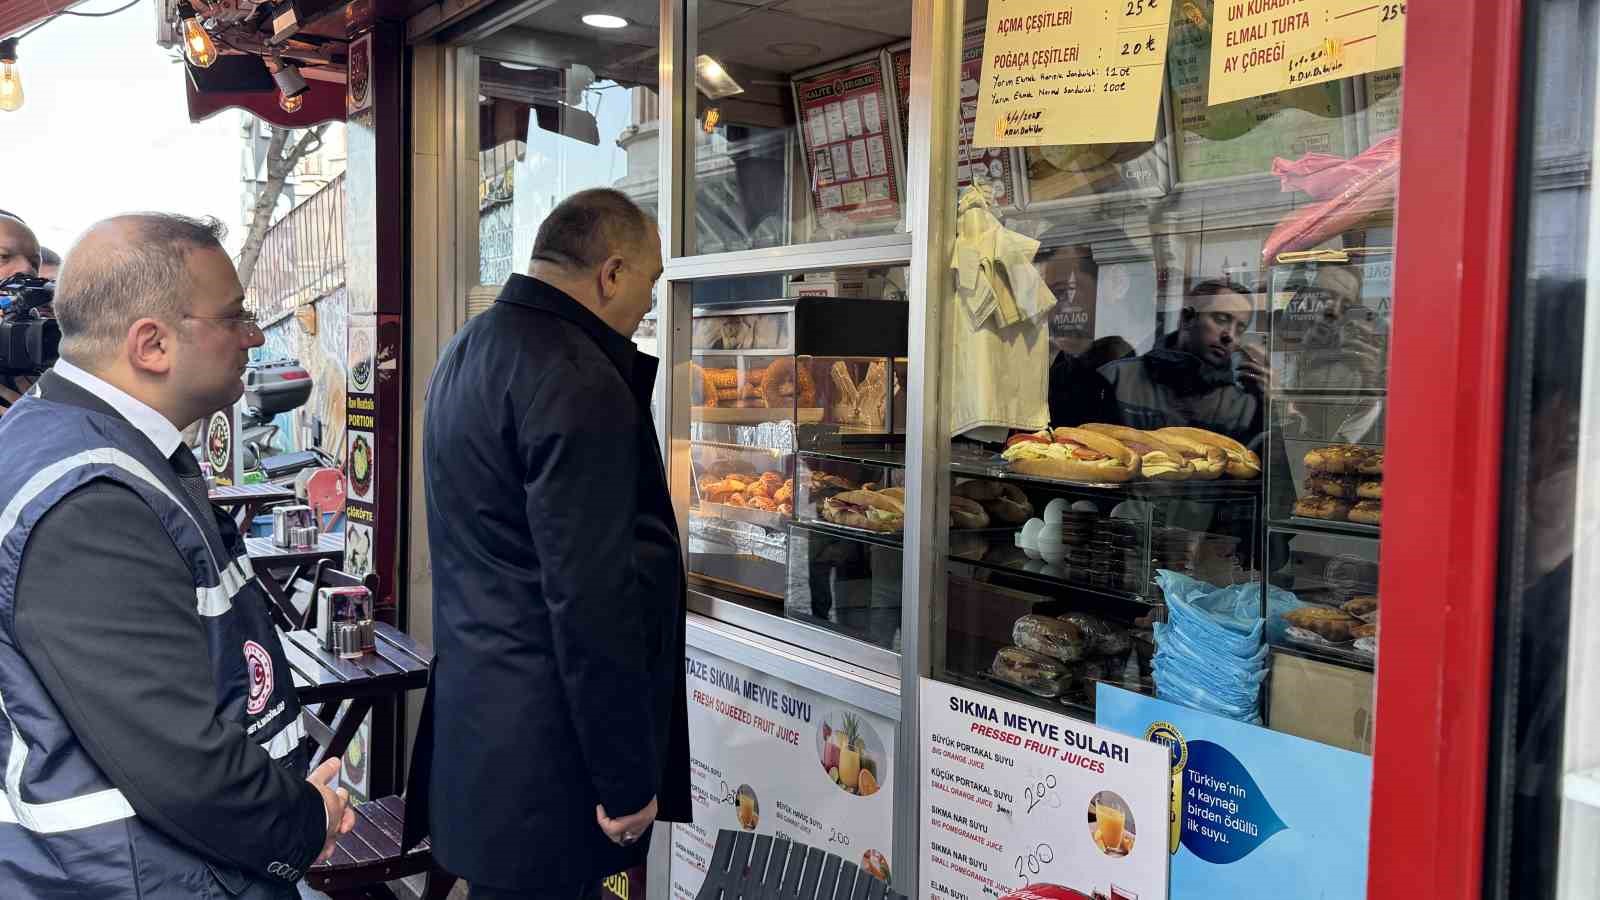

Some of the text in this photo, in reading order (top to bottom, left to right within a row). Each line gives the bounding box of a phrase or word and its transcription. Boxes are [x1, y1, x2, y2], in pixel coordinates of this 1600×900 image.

[997, 8, 1073, 36] AÇMA ÇEŞİTLERİ
[1228, 4, 1245, 22] UN
[1226, 11, 1310, 48] ELMALI TURTA
[993, 50, 1029, 70] POĞAÇA
[1031, 44, 1080, 70] ÇEŞİTLERİ
[1224, 41, 1286, 74] AY ÇÖREĞİ
[348, 414, 374, 428] PORTION
[686, 657, 811, 723] TAZE SIKMA MEYVE SUYU
[693, 689, 800, 746] FRESH SQUEEZED FRUIT JUICE
[950, 697, 998, 723] SIKMA
[1003, 711, 1058, 741] MEYVE
[1064, 730, 1129, 764] SULARI
[931, 734, 1014, 768] BÜYÜK PORTAKAL SUYU
[943, 750, 967, 766] ORANGE
[967, 757, 985, 770] JUICE
[971, 722, 1105, 774] PRESSED FRUIT JUICES
[931, 767, 1013, 804] KÜÇÜK PORTAKAL SUYU
[931, 780, 993, 809] SMALL ORANGE JUICE
[1187, 769, 1247, 800] Türkiye'nin
[1188, 787, 1239, 815] 4 kaynağı
[931, 805, 988, 834] SIKMA NAR SUYU
[1187, 802, 1258, 838] birden ödüllü
[1187, 818, 1230, 846] ilk suyu.
[942, 821, 985, 846] POMEGRANATE
[985, 837, 1003, 852] JUICE
[931, 841, 988, 872] SIKMA NAR SUYU
[930, 880, 949, 895] ELMA
[950, 862, 994, 889] POMEGRANATE
